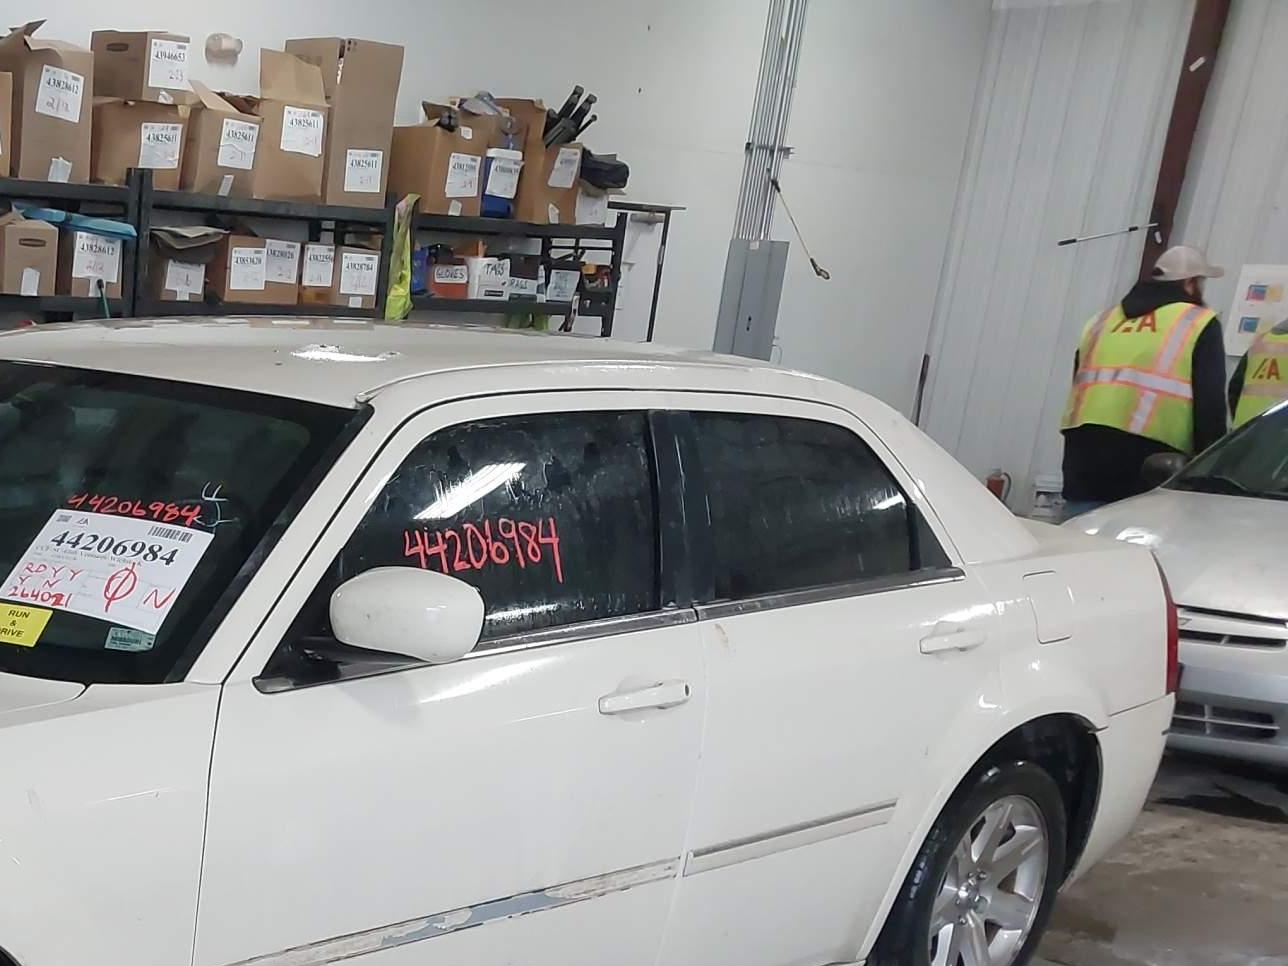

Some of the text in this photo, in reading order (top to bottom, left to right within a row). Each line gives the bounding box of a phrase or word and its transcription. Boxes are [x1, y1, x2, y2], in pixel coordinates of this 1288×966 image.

[80, 243, 115, 258] 43828612
[435, 267, 465, 280] GLOVES
[484, 263, 505, 276] TAGS
[68, 493, 202, 526] 44206984
[51, 530, 179, 566] 44206984
[404, 517, 563, 584] 44206984
[7, 609, 31, 619] RUN
